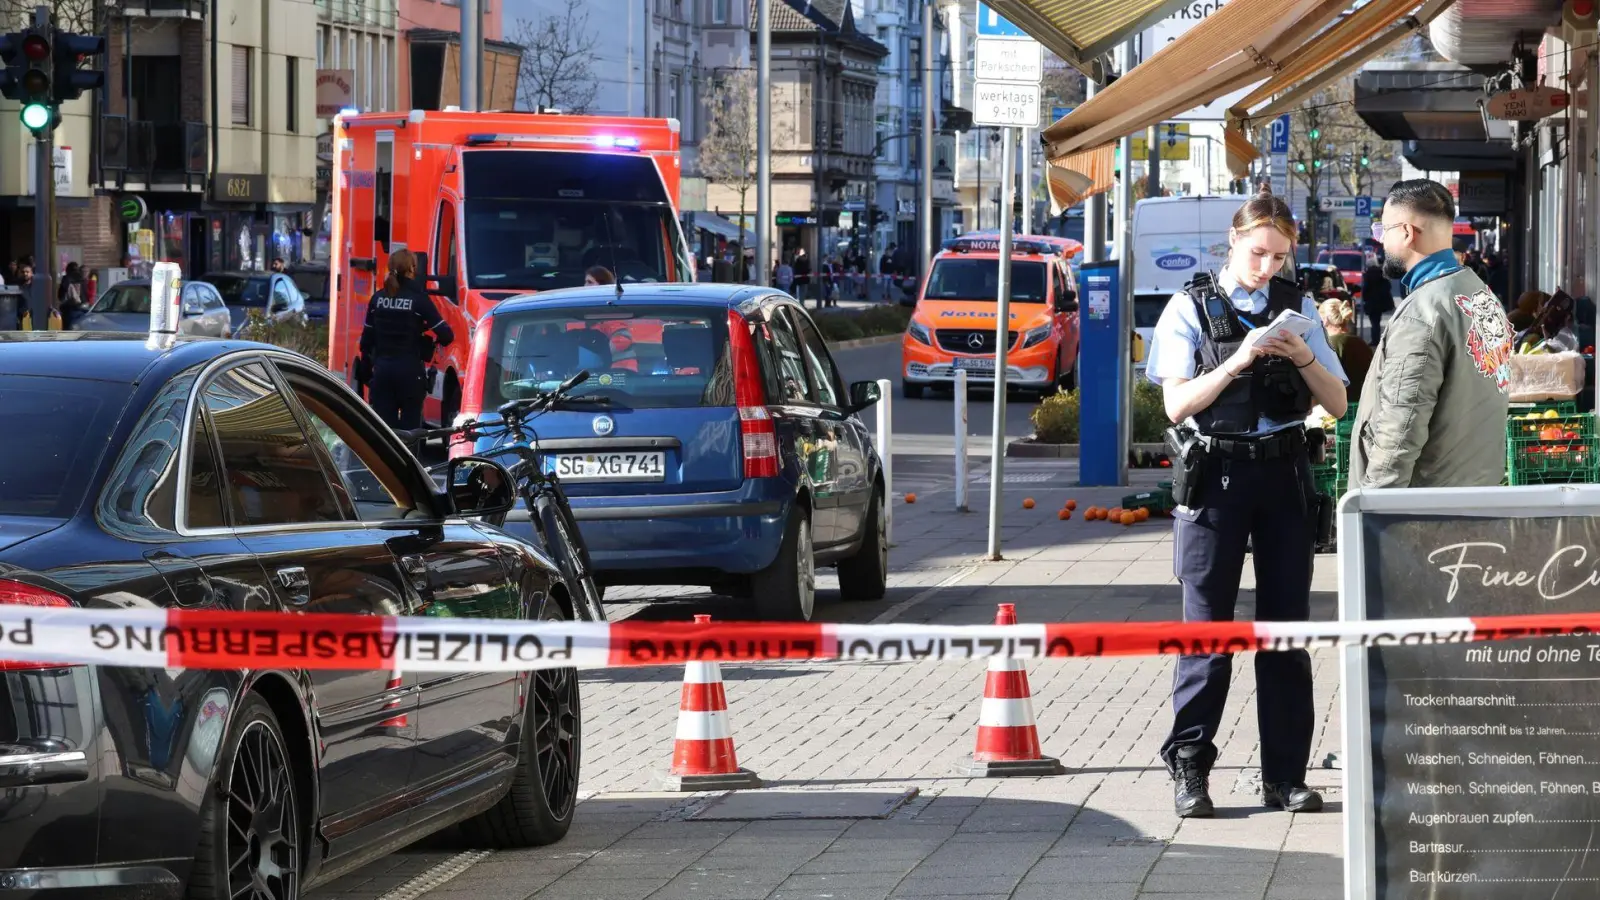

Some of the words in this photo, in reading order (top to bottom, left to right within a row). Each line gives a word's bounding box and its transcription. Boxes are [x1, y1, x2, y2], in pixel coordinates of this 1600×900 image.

[1001, 50, 1017, 58] mit
[980, 60, 1037, 73] Parkschein
[980, 91, 1035, 106] werktags
[227, 178, 250, 196] 6821
[1356, 200, 1367, 215] P
[970, 240, 1018, 251] NOTAT
[376, 297, 413, 311] POLIZEI
[940, 310, 1017, 320] Notart
[596, 421, 610, 430] FIAT
[559, 455, 584, 475] SG
[597, 455, 622, 474] XG
[625, 454, 662, 474] 741
[1428, 541, 1536, 603] Fine
[90, 623, 573, 660] POLIZEIABSPERRUNG
[1465, 646, 1492, 662] mit
[1497, 646, 1531, 662] und
[1536, 646, 1581, 662] ohne
[1404, 694, 1516, 706] Trockenhaarschnitt
[1405, 723, 1507, 736] Kinderhaarschnit
[1510, 726, 1522, 735] bis
[1525, 727, 1535, 735] 12
[1537, 726, 1565, 735] Jahren
[1406, 753, 1465, 767] Waschen,
[1468, 752, 1536, 766] Schneiden,
[1539, 752, 1584, 765] Föhnen
[1407, 782, 1465, 795] Waschen,
[1469, 781, 1537, 795] Schneiden,
[1540, 781, 1589, 795] Föhnen,
[1408, 812, 1489, 827] Augenbrauen
[1493, 811, 1534, 826] zupfen
[1409, 840, 1464, 853] Bartrasur
[1409, 870, 1435, 882] Bart
[1438, 870, 1477, 882] kürzen
